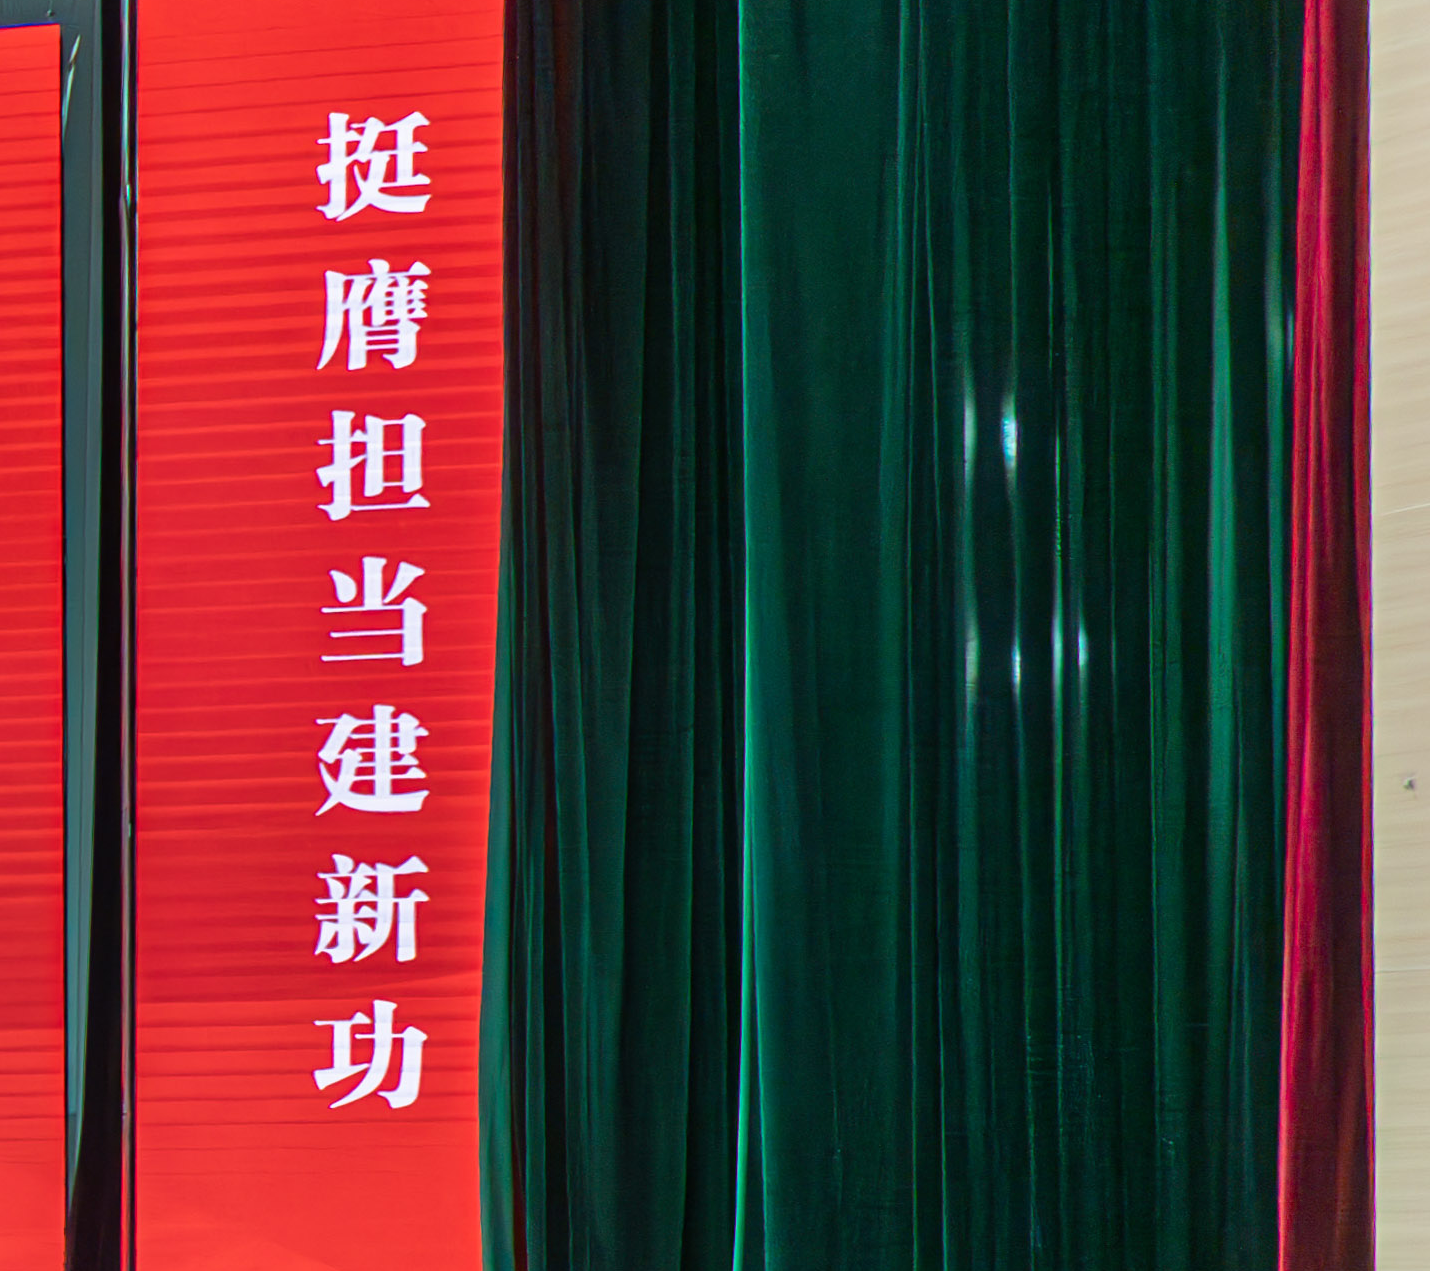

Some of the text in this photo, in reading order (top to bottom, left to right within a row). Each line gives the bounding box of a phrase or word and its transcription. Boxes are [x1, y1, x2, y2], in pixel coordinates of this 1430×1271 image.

[314, 111, 431, 1109] 挺膺担当建新功
